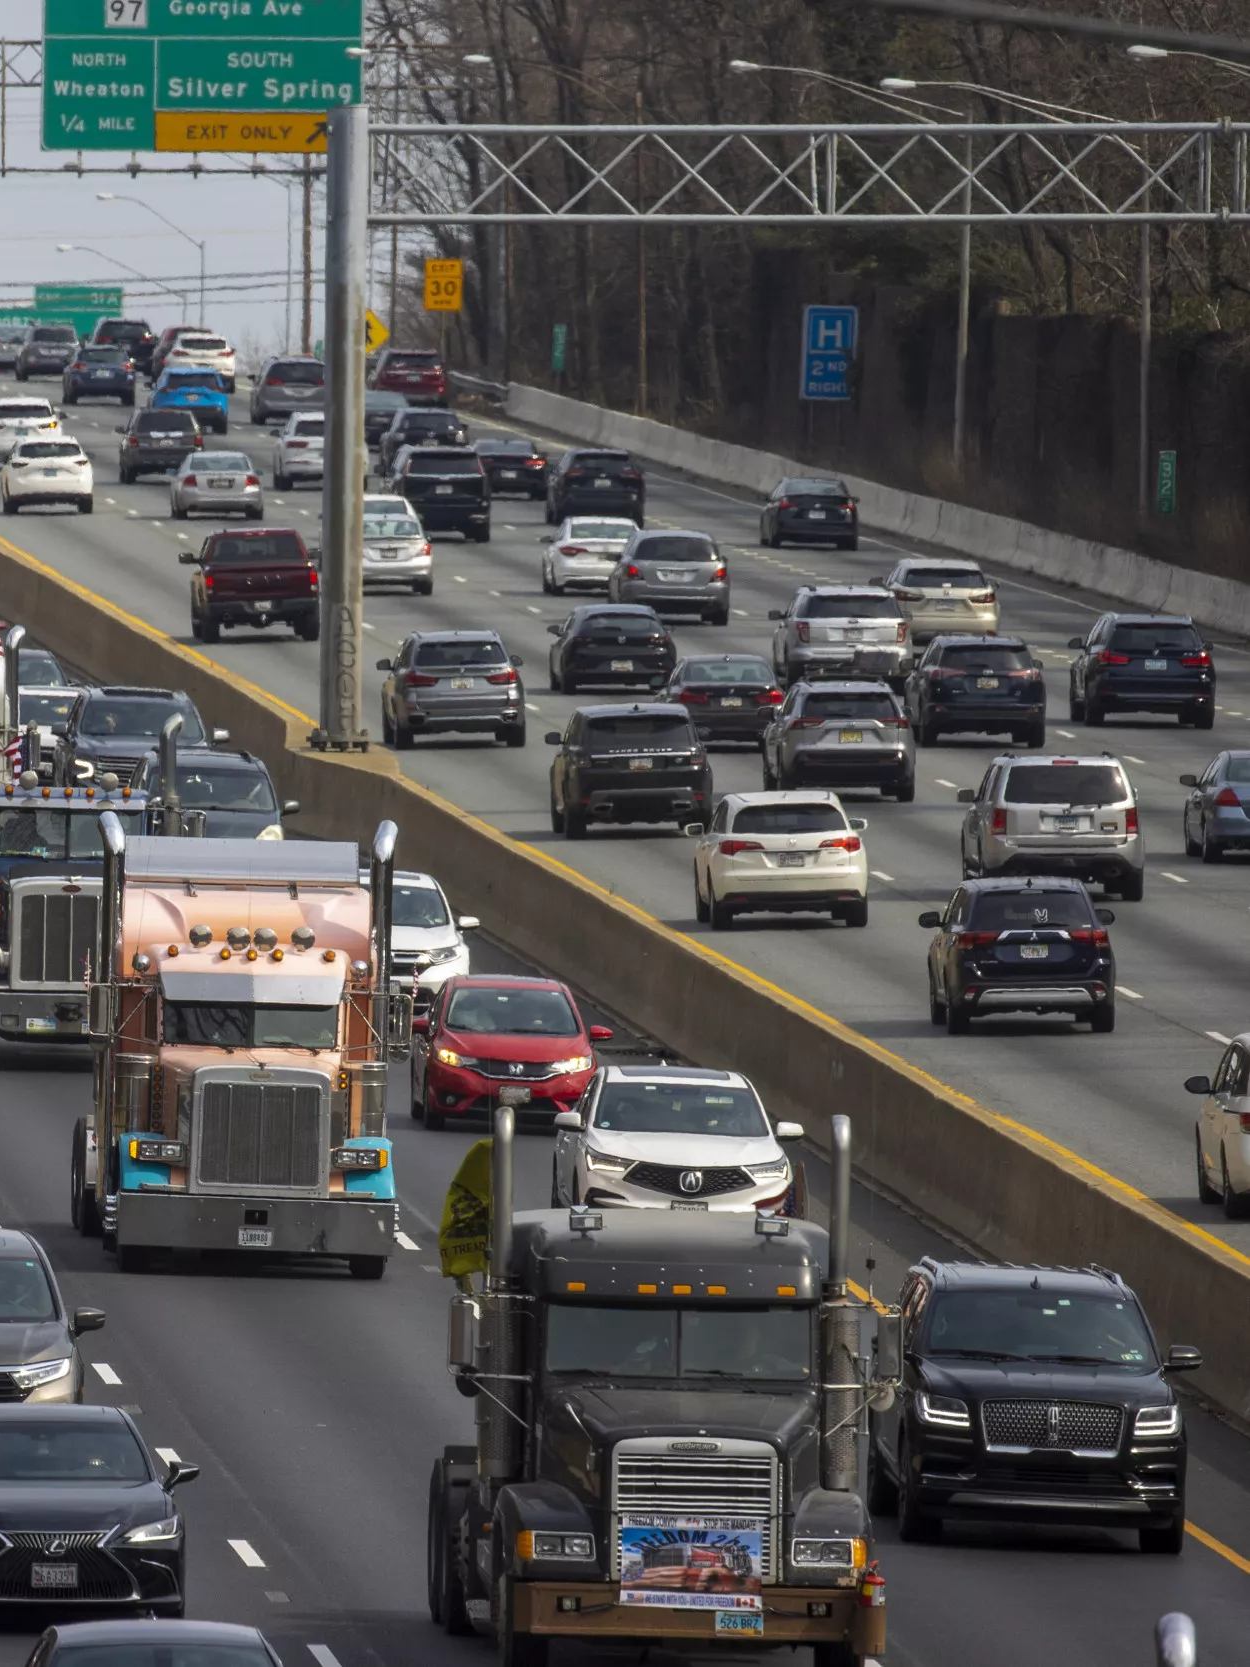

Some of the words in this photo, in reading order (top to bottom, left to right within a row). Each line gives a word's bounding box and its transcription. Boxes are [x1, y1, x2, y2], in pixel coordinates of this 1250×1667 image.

[110, 0, 142, 22] 97
[169, 0, 250, 19] Georgia
[262, 0, 303, 15] Ave
[72, 53, 126, 66] NORTH
[227, 52, 293, 68] SOUTH
[53, 80, 144, 97] Wheaton
[168, 77, 247, 98] Silver
[264, 78, 353, 104] Spring
[98, 117, 135, 131] MILE
[186, 125, 228, 140] EXIT
[240, 125, 293, 140] ONLY
[430, 280, 456, 297] 30
[818, 319, 842, 348] H
[453, 1241, 486, 1254] TREAD
[673, 1442, 716, 1451] FREIGHTLINER
[656, 1516, 678, 1528] CONVOY
[703, 1518, 718, 1530] STOP
[719, 1519, 729, 1531] THE
[731, 1519, 757, 1531] MANDATE
[719, 1617, 739, 1629] 526
